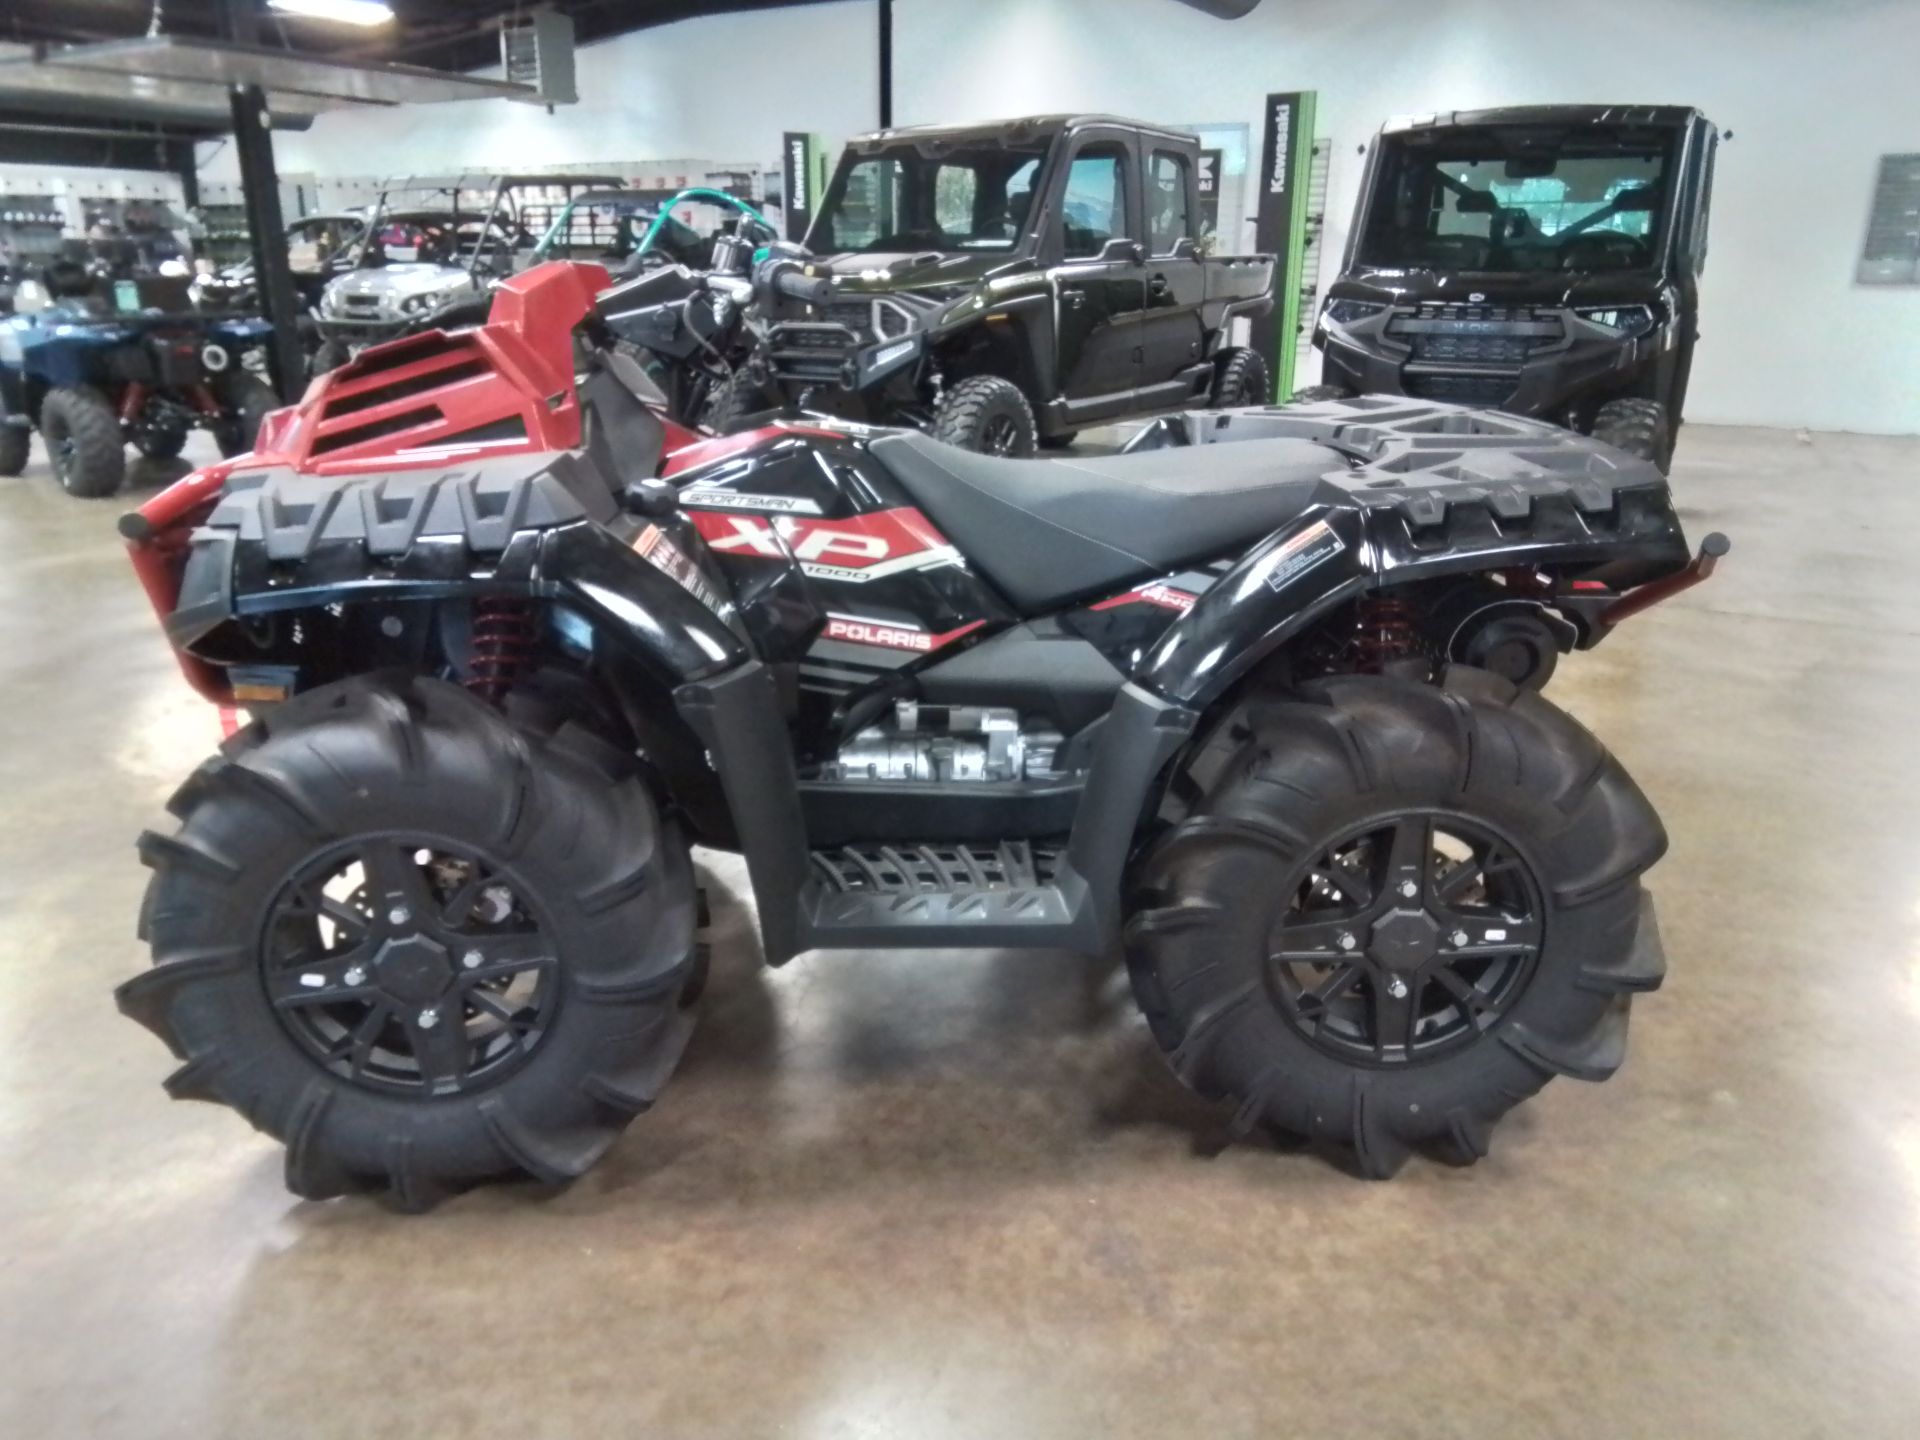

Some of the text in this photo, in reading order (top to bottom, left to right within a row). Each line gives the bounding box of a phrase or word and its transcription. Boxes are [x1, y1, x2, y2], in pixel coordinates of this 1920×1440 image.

[1270, 103, 1290, 193] Kawasaki
[792, 140, 805, 210] Kawasaki
[690, 492, 796, 509] SPORTSMAN
[707, 516, 890, 561] XP
[807, 565, 871, 580] 1000
[829, 620, 932, 650] POLARIS
